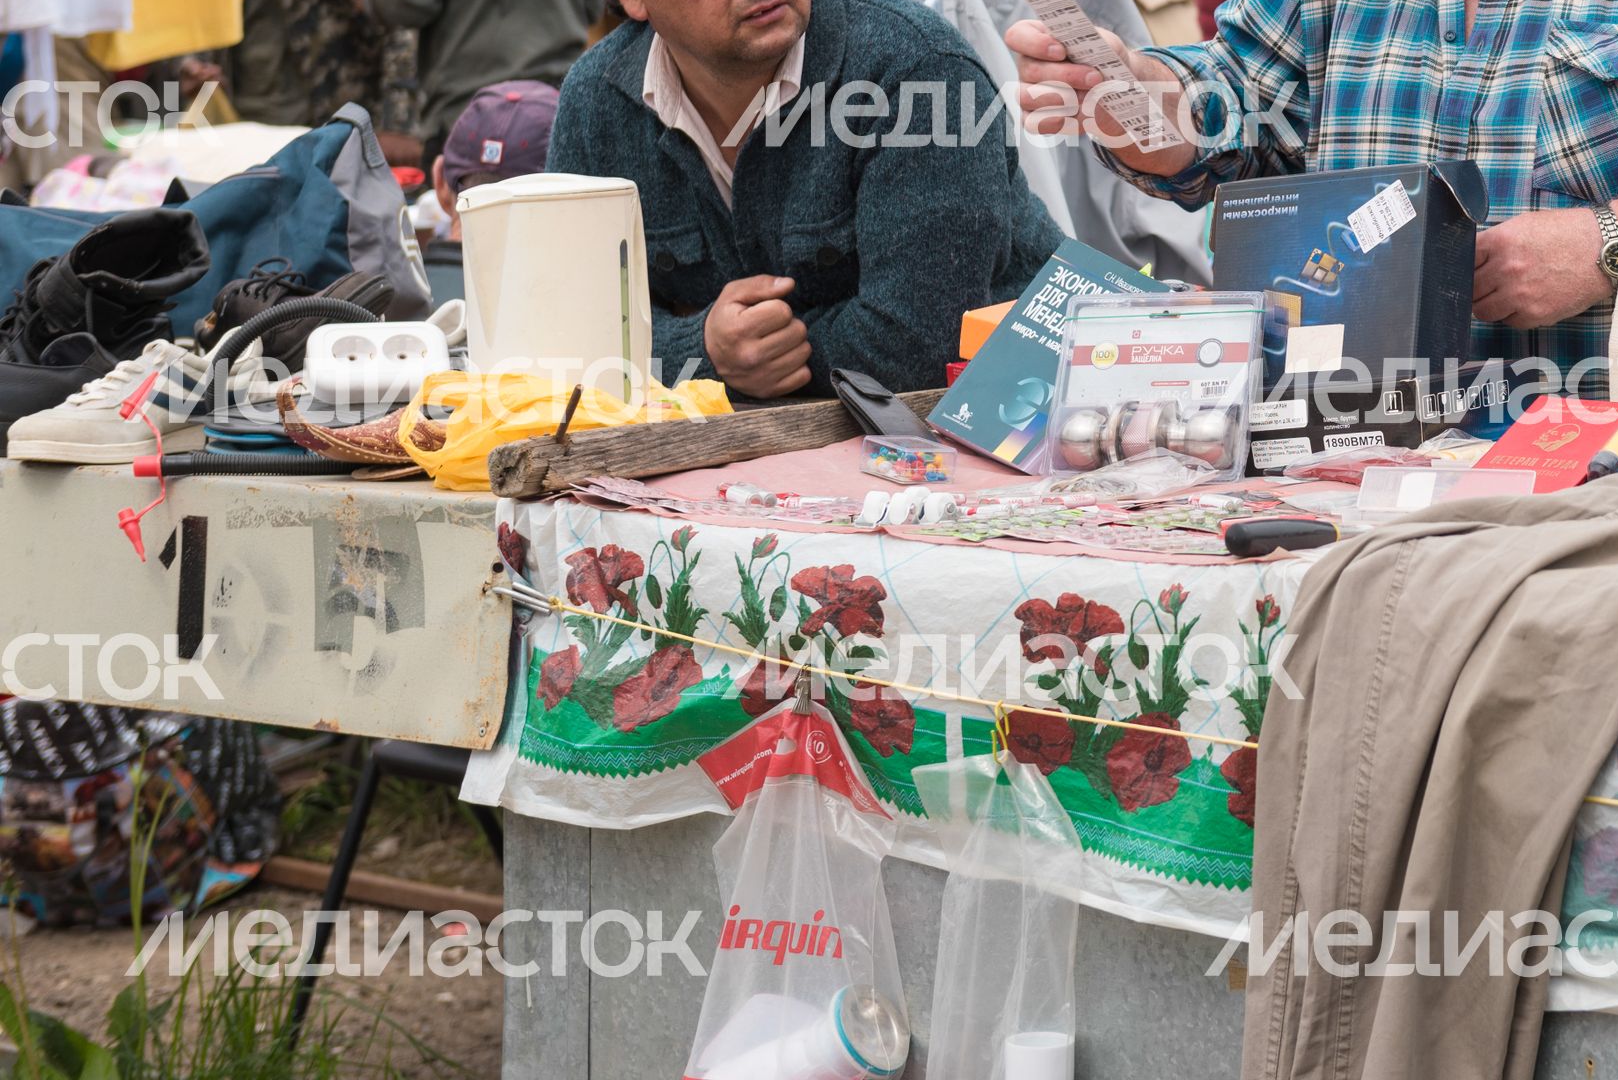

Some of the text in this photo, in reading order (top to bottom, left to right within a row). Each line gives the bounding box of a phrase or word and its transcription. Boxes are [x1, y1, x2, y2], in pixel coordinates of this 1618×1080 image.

[1223, 193, 1299, 208] интегральные
[1223, 205, 1298, 221] Микросхемы
[1033, 284, 1068, 308] ДЛЯ
[1022, 301, 1067, 337] МЕНЕД
[1131, 345, 1184, 356] РУЧКА
[1131, 355, 1162, 364] ЗАЩЕЛКА
[1325, 435, 1383, 448] 1890ВМ7Я
[1489, 455, 1579, 470] ВЕТЕРАН ТРУДА
